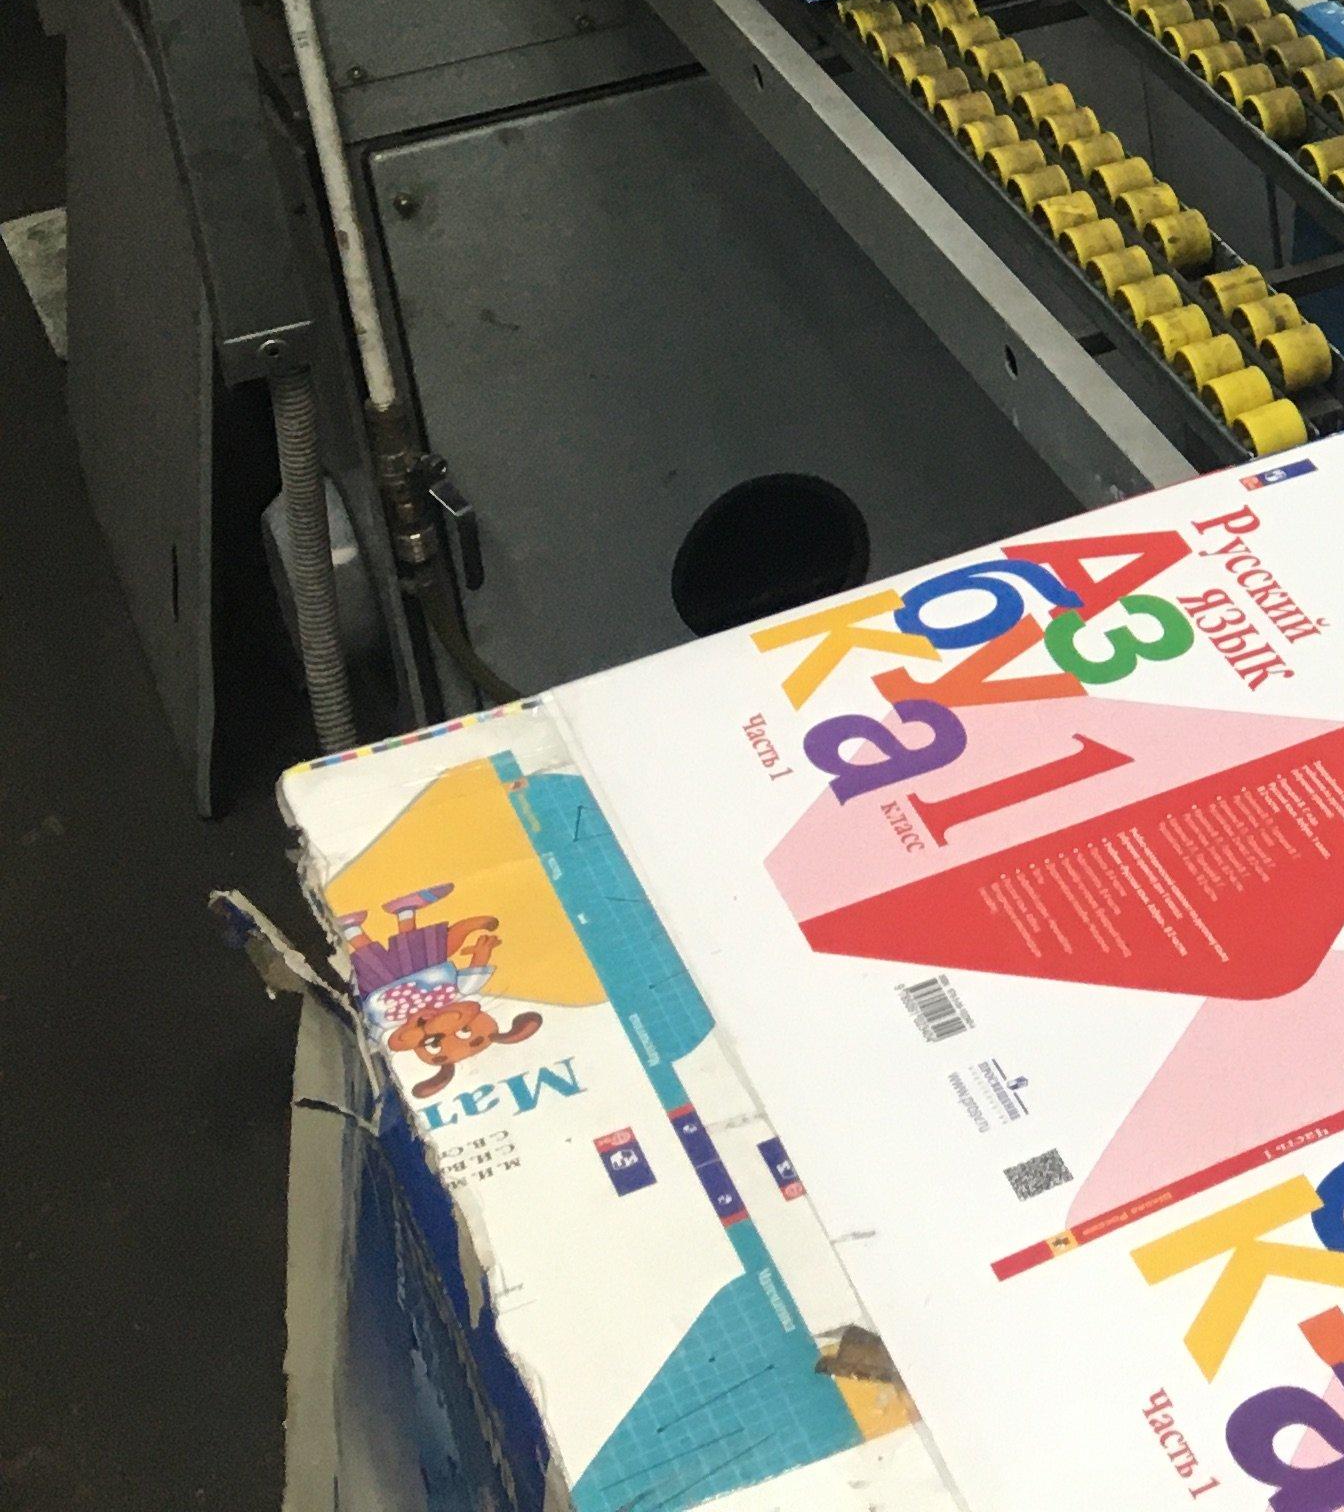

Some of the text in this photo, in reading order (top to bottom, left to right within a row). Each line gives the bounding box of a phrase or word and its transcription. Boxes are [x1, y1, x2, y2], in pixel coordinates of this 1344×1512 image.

[1191, 505, 1326, 646] Русский
[1177, 588, 1295, 691] язык
[742, 714, 794, 781] Часть 1
[907, 733, 1135, 848] 1
[881, 801, 927, 854] класс
[1142, 1387, 1220, 1501] Часть 1
